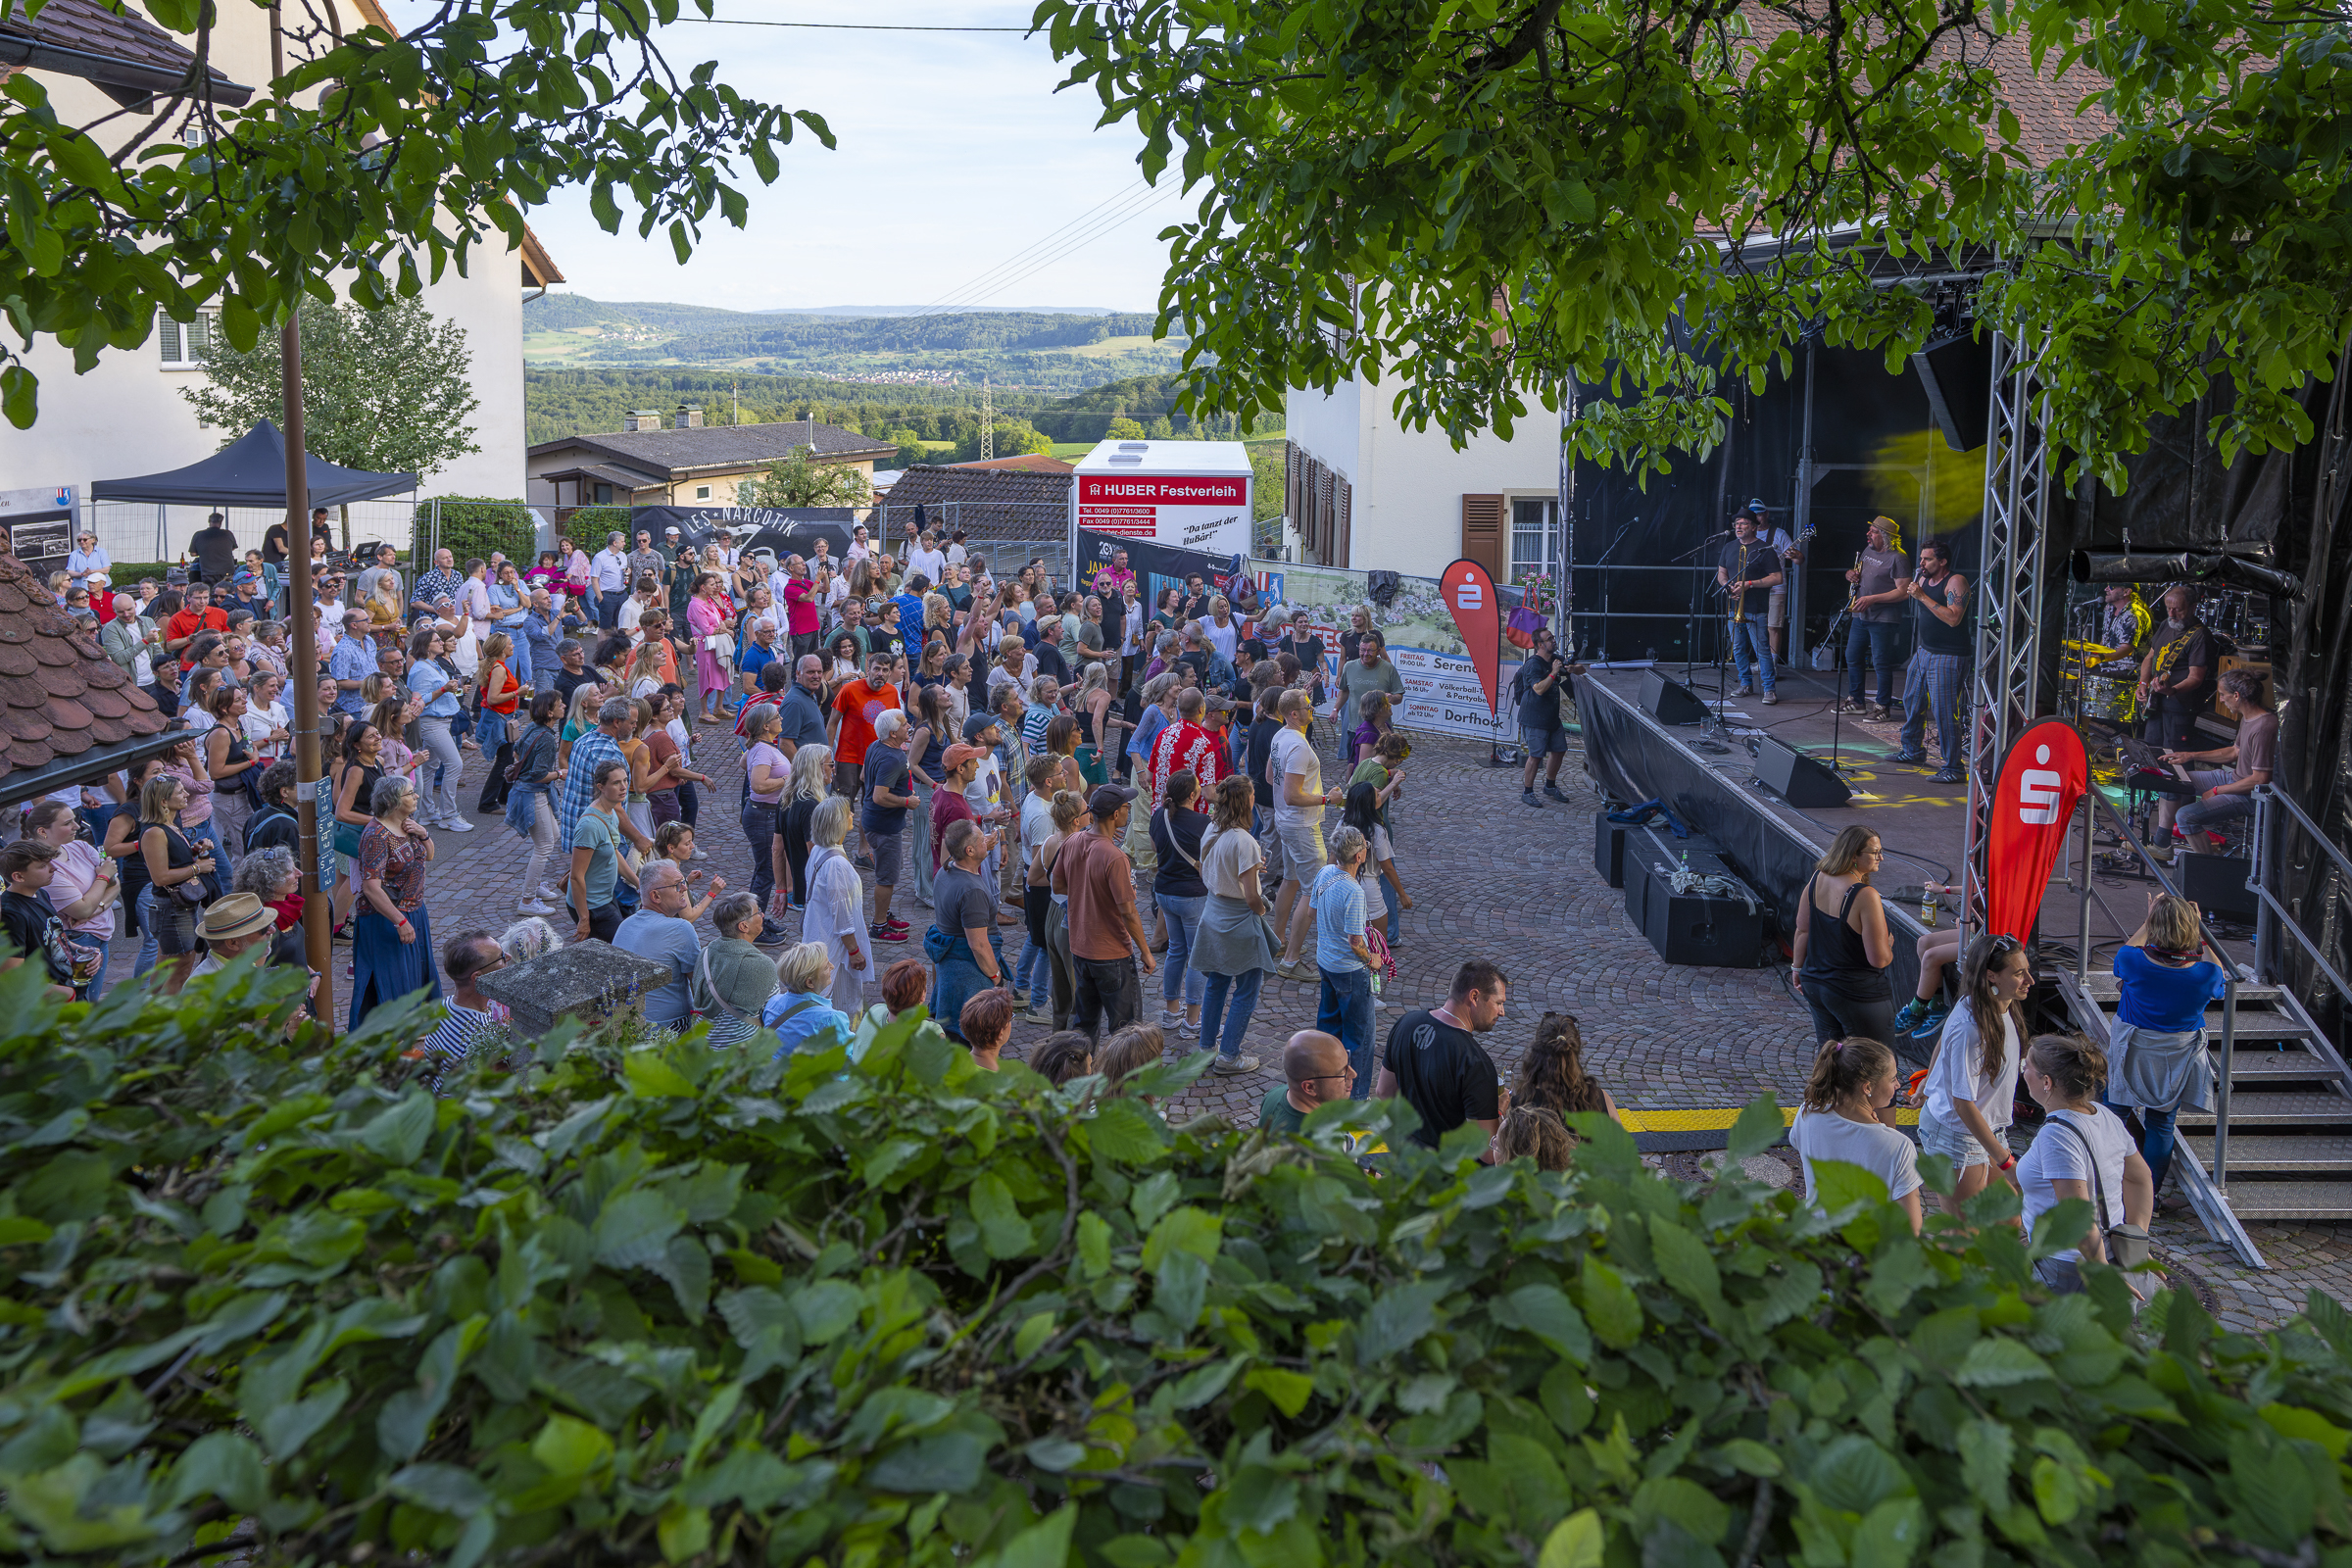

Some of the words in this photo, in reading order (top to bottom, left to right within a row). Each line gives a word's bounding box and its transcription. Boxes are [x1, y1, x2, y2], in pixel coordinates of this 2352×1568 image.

[1104, 484, 1156, 496] HUBER
[1160, 484, 1237, 497] Festverleih
[684, 510, 711, 534] LES
[723, 506, 799, 538] NARCOTIK
[1201, 518, 1223, 530] tanzt
[1224, 516, 1238, 525] der
[1405, 678, 1433, 687] SAMSTAG
[1439, 683, 1504, 698] Völkerball-Ter
[1409, 704, 1439, 712] SONNTAG
[318, 786, 322, 795] S
[319, 823, 324, 833] S
[320, 860, 325, 869] S
